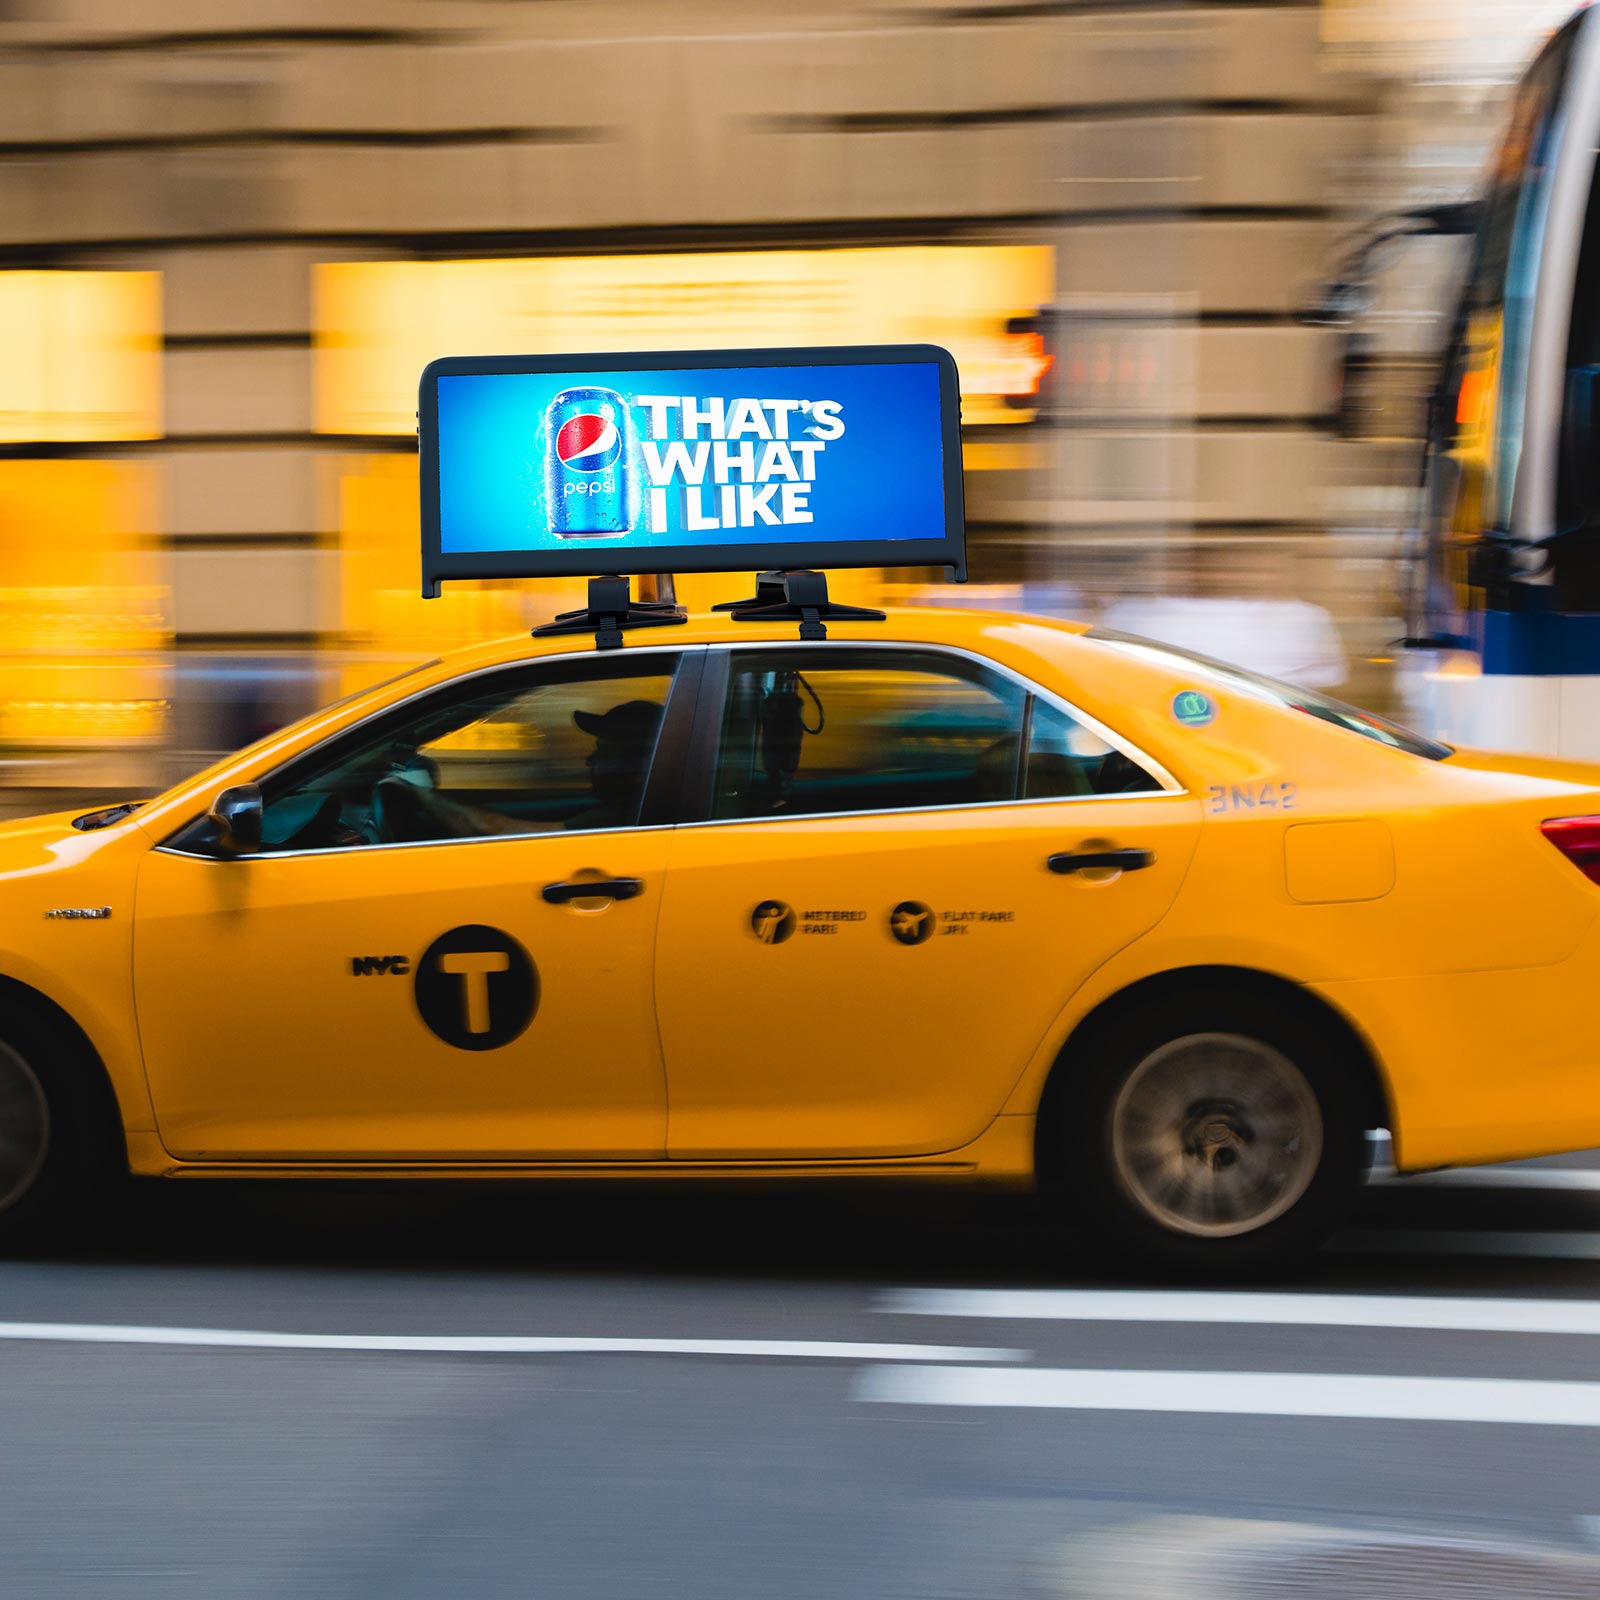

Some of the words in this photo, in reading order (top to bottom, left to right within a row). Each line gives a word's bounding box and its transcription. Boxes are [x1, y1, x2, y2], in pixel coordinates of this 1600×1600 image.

[636, 394, 846, 442] THAT'S
[643, 441, 826, 486] WHAT
[563, 480, 616, 499] pepsi
[649, 488, 668, 533] I
[686, 482, 814, 531] LIKE
[1209, 782, 1297, 813] 3N42
[803, 910, 867, 922] METERED
[803, 924, 838, 935] FARE
[943, 910, 976, 922] FLAT
[979, 910, 1015, 922] FARE
[351, 955, 410, 976] NYC
[441, 951, 510, 1034] T
